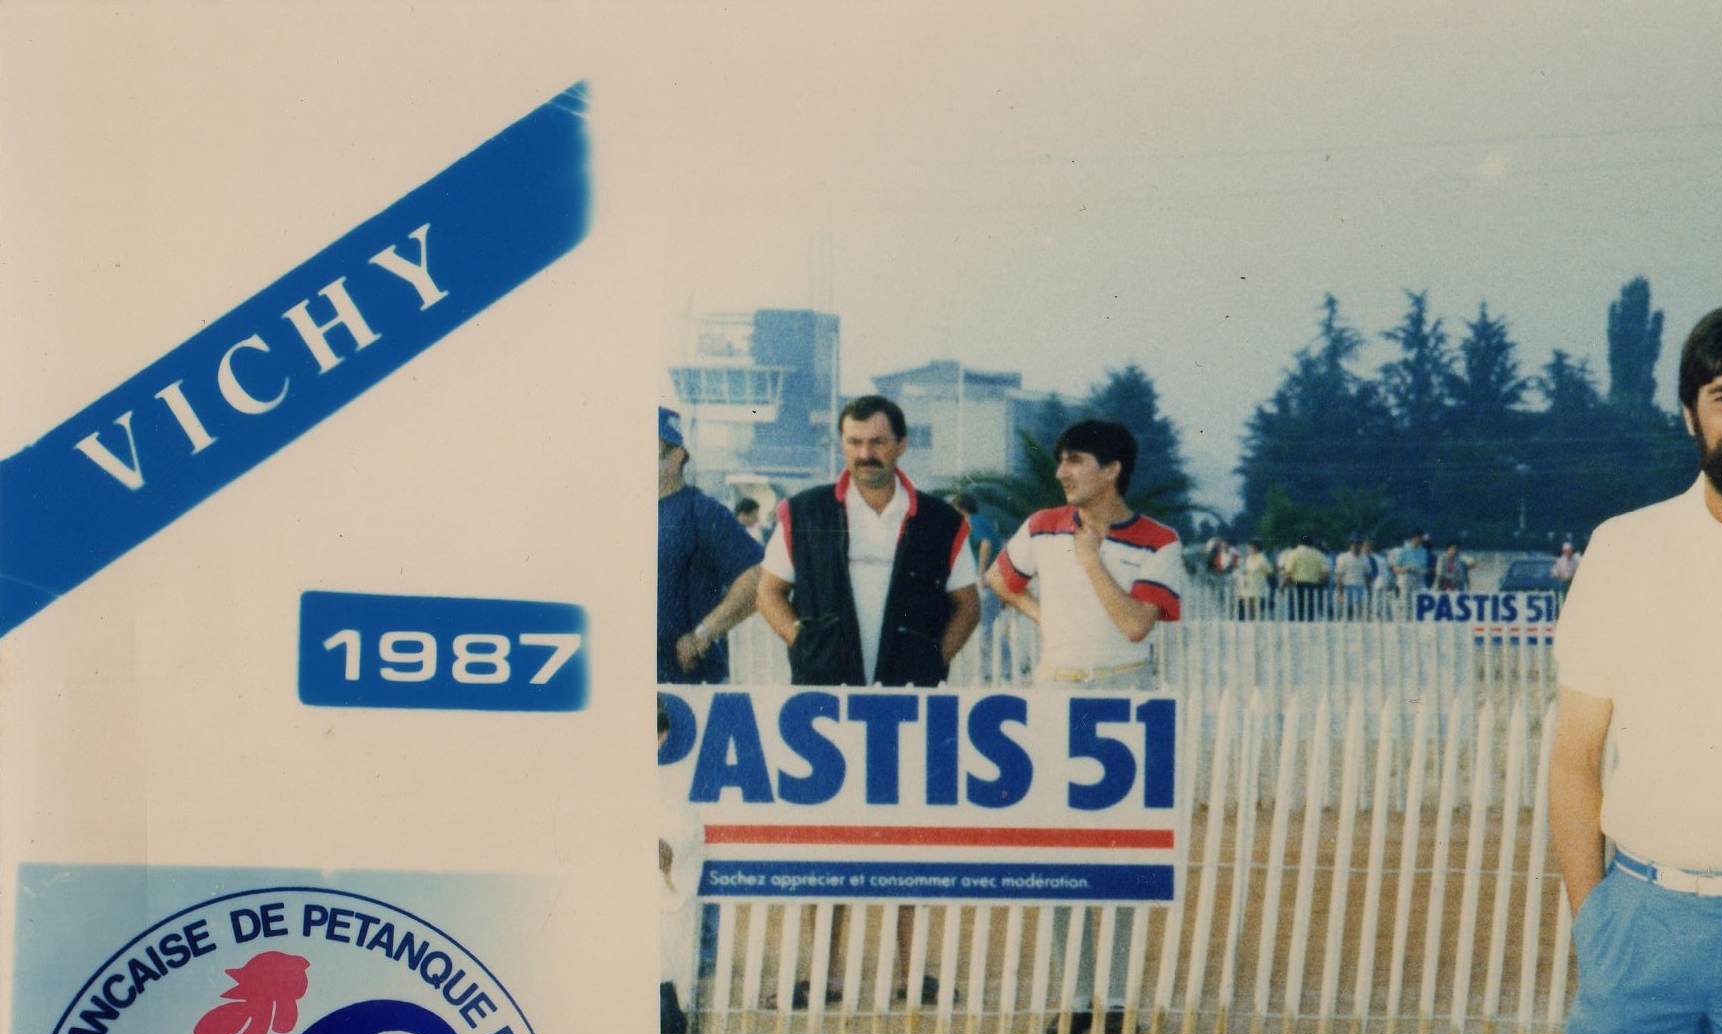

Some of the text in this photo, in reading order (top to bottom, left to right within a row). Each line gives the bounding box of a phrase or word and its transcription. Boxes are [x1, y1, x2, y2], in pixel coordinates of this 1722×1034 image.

[1416, 594, 1553, 623] PASTIS 51
[1067, 697, 1177, 812] 51
[709, 870, 767, 886] Sachez
[770, 871, 845, 891] apprécier
[849, 873, 865, 887] et
[869, 875, 958, 888] consommer
[961, 875, 997, 888] avec
